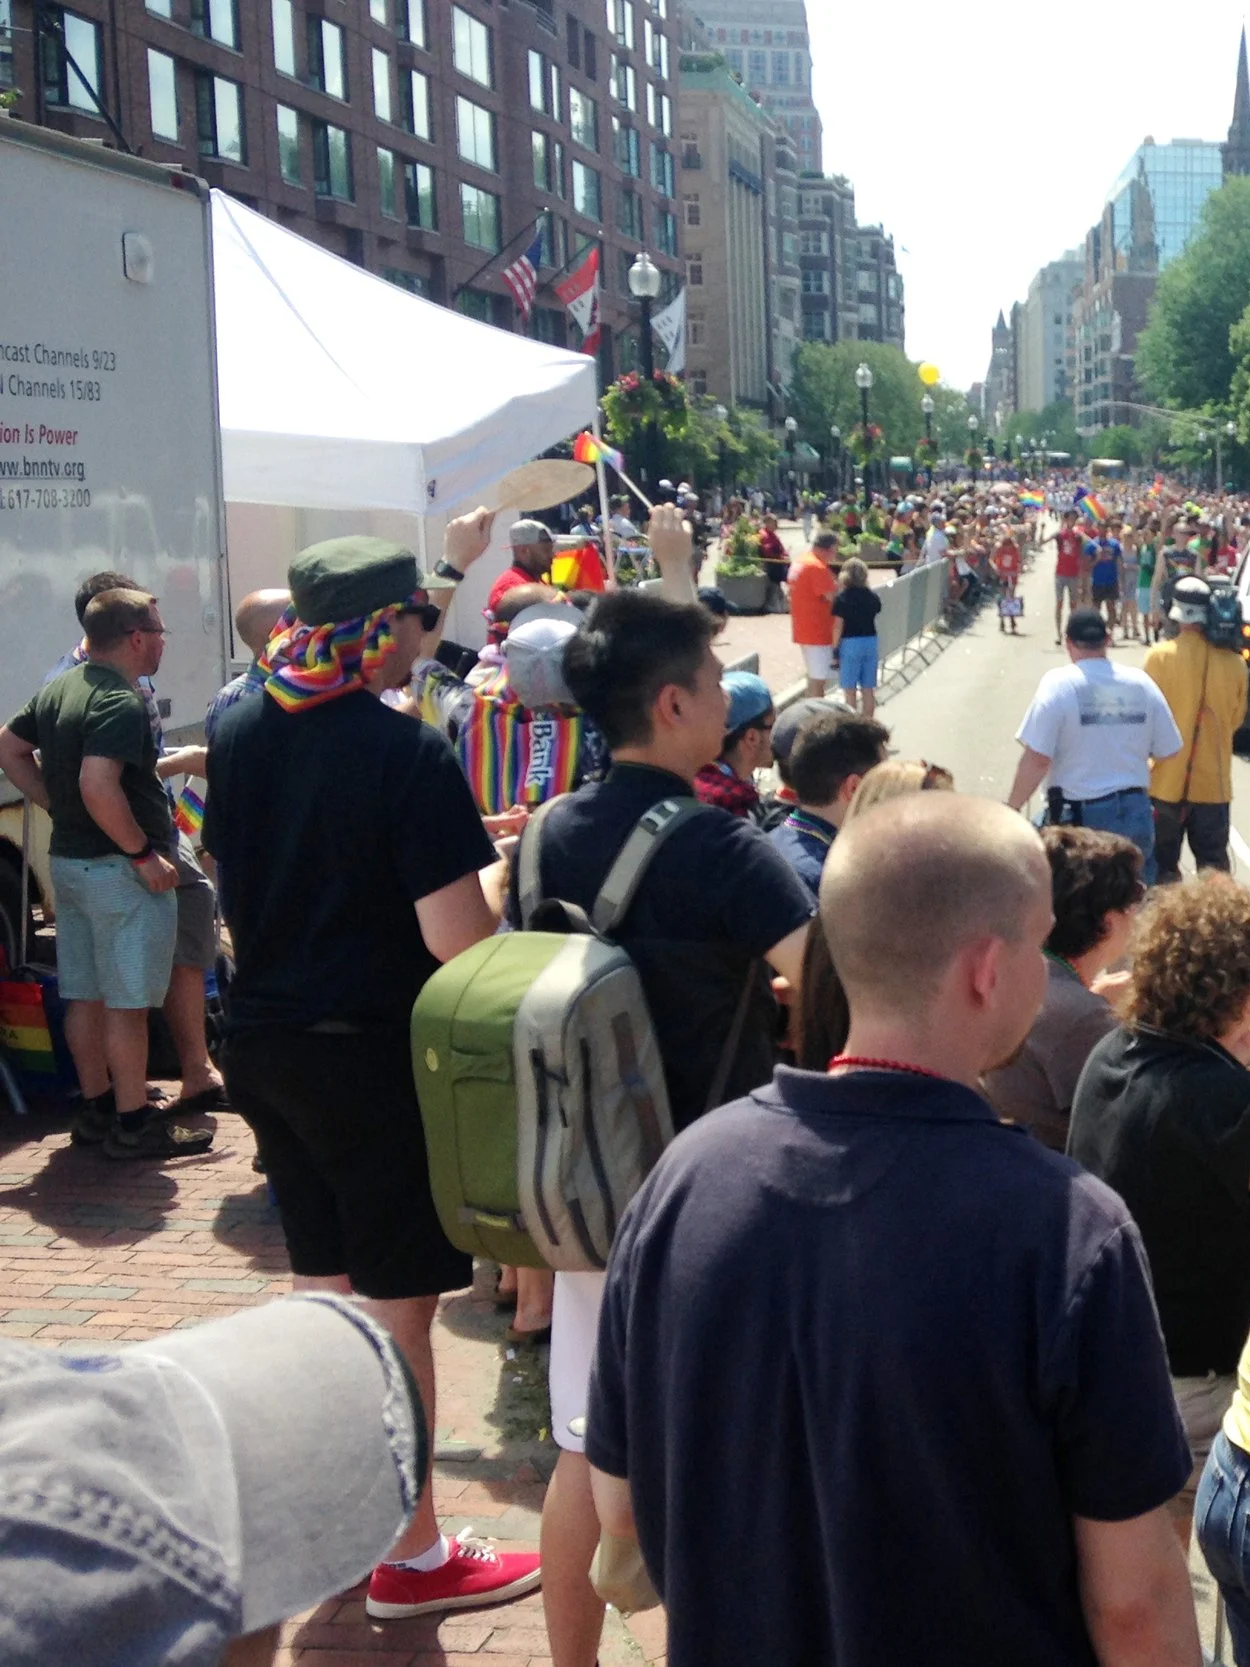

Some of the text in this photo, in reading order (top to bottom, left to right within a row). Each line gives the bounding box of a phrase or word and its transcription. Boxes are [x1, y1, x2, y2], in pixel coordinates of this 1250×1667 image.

[34, 343, 89, 369] Channels
[92, 350, 116, 371] 9/23
[8, 374, 65, 399] Channels
[70, 379, 100, 401] 15/83
[24, 423, 35, 444] Is
[38, 424, 79, 445] Power
